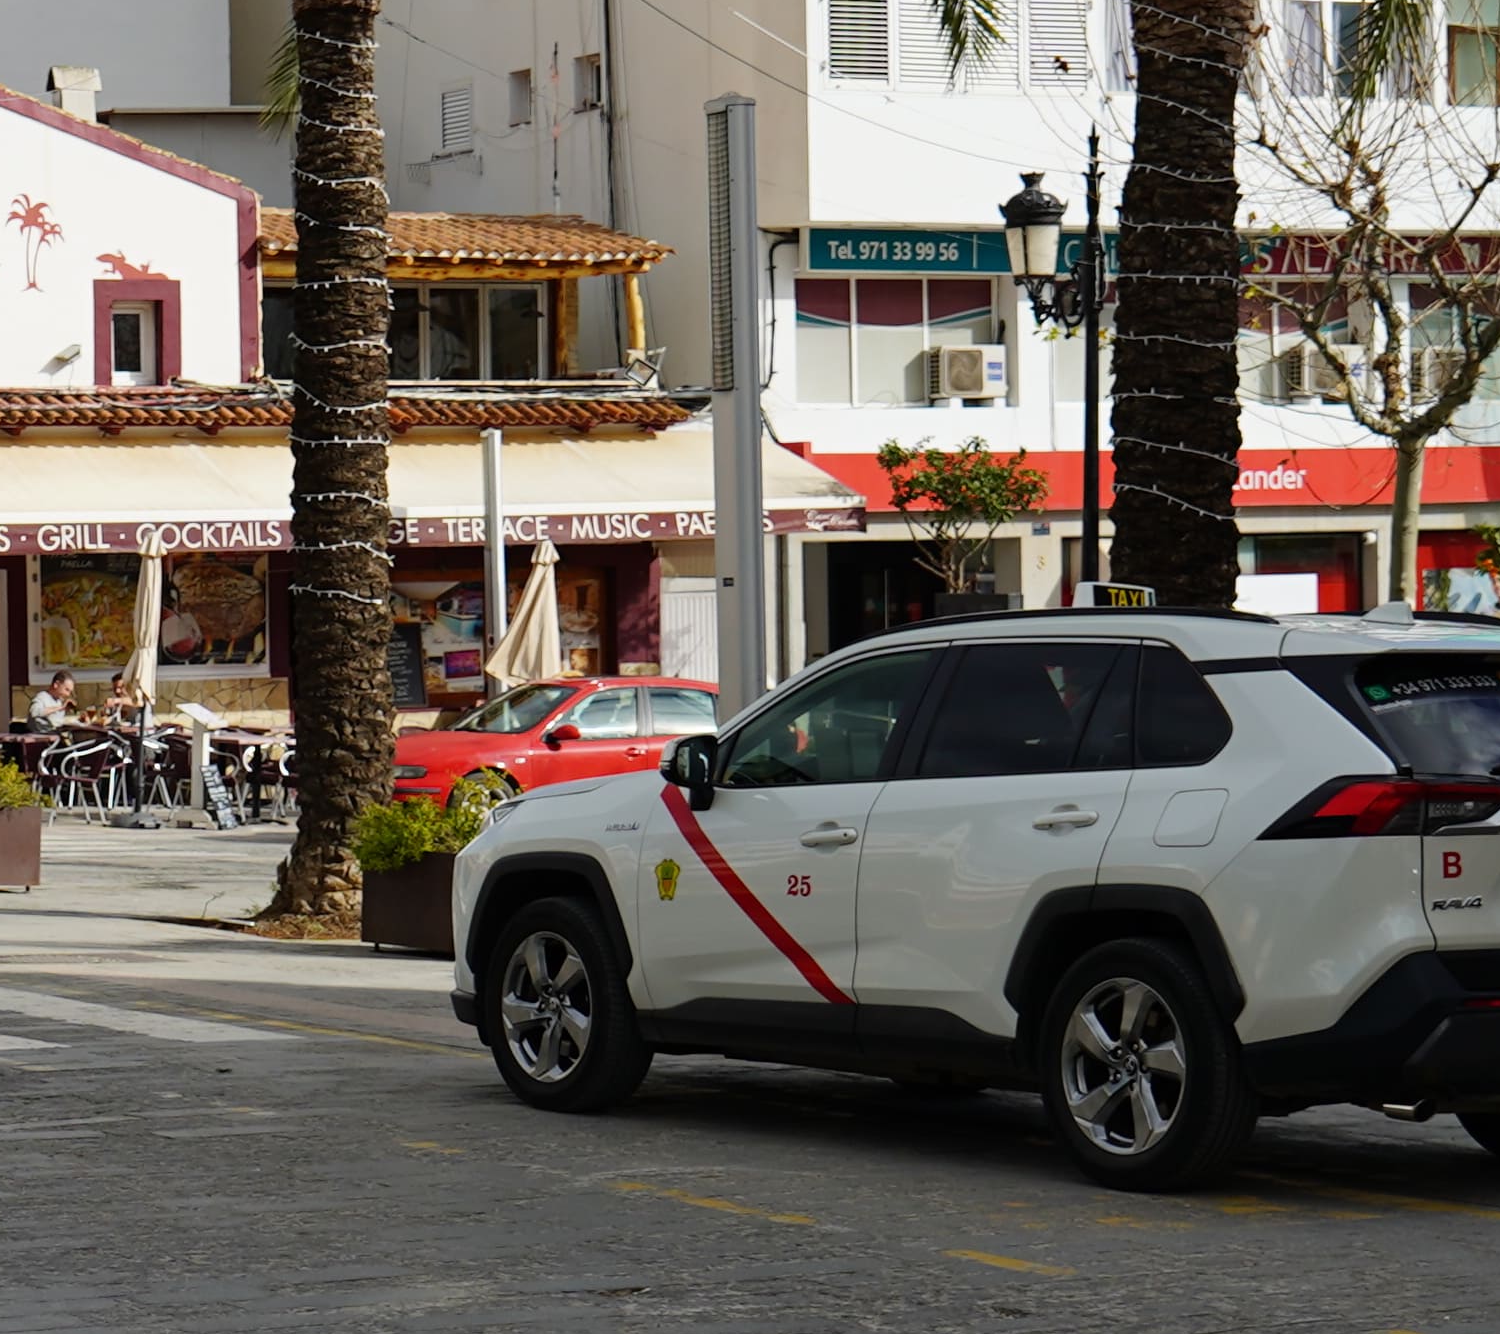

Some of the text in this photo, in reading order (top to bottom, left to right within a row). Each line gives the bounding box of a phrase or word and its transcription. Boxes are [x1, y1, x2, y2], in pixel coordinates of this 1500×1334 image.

[827, 240, 959, 262] Tel. 971 33 99 56
[1232, 465, 1307, 491] ander
[37, 523, 111, 552] GRILL
[136, 521, 283, 550] COCKTAILS
[442, 516, 550, 543] TERACE
[570, 512, 652, 541] MUSIC
[676, 510, 774, 536] PAES
[1107, 587, 1145, 607] TAXI
[1442, 851, 1463, 879] B
[787, 874, 812, 897] 25
[1431, 896, 1483, 912] RAV4
